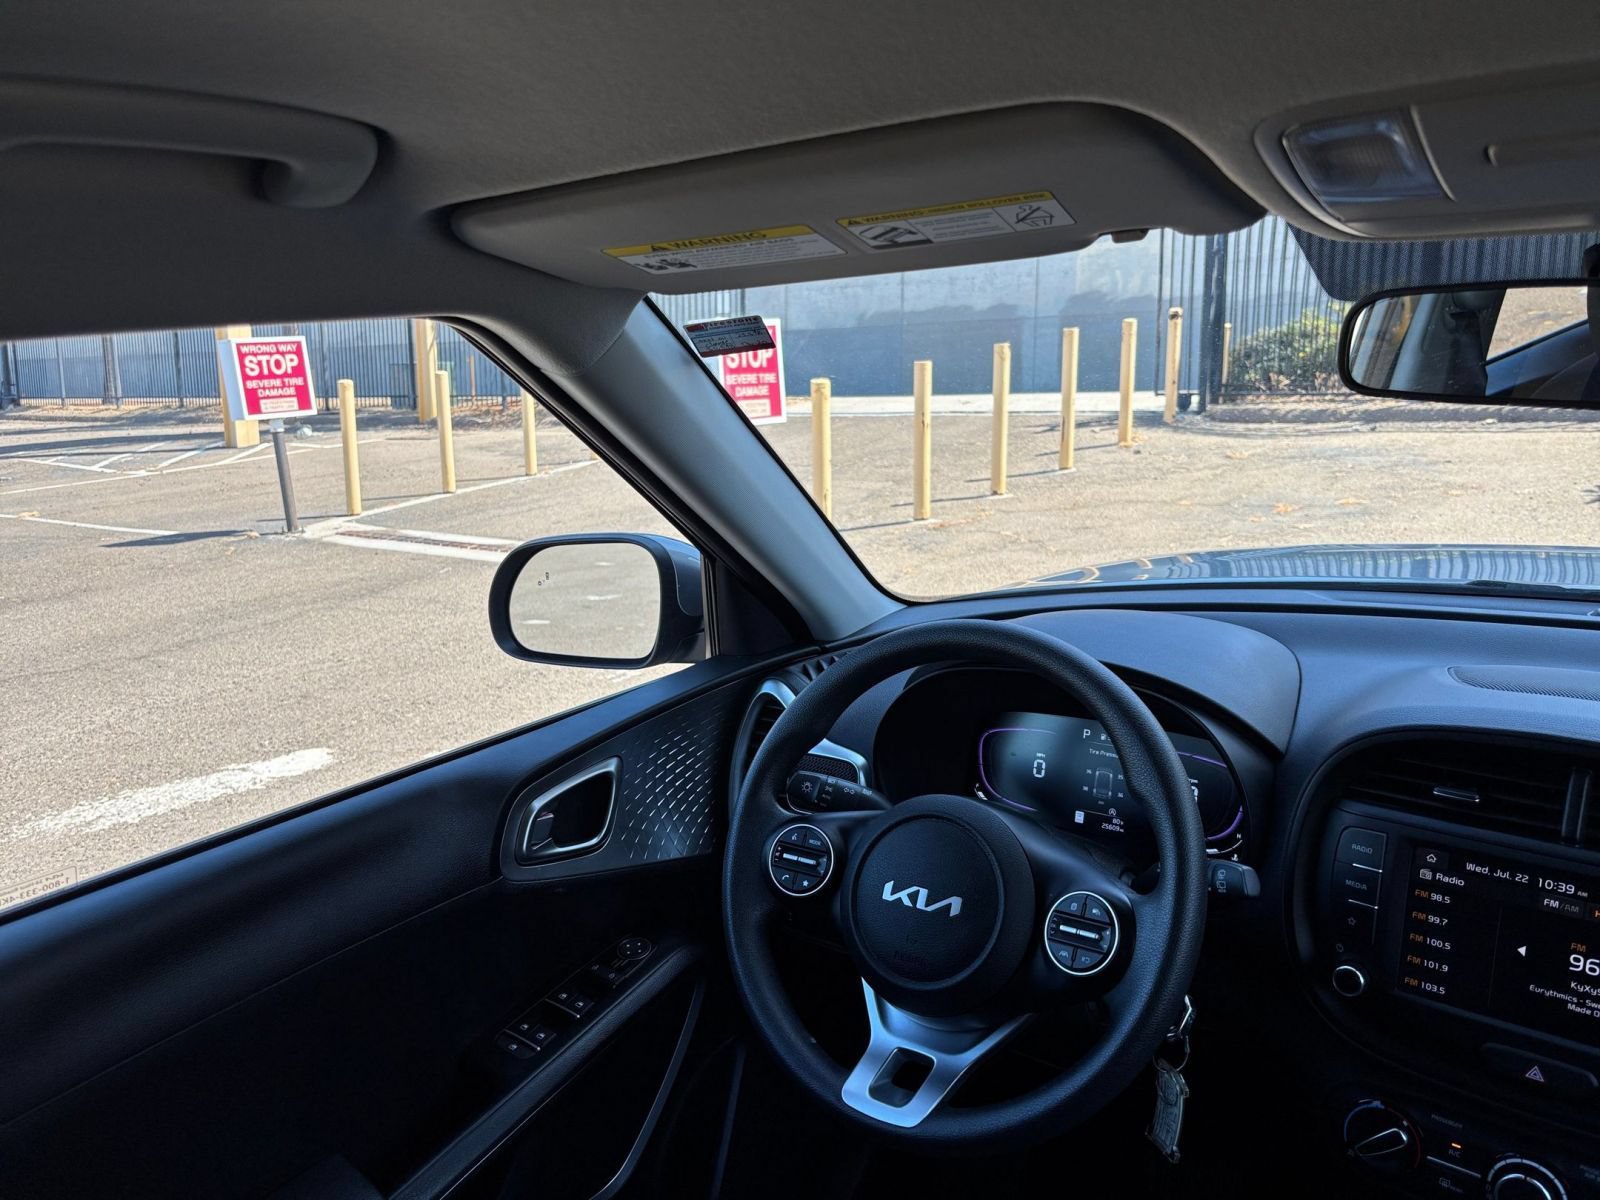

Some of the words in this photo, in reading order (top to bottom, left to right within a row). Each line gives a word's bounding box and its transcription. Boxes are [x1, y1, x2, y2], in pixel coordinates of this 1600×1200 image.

[670, 231, 767, 250] WARNING
[240, 344, 277, 354] WRONG
[278, 343, 297, 352] WAY
[244, 353, 299, 376] STOP
[725, 348, 774, 369] STOP
[246, 379, 282, 389] SEVERE
[284, 376, 304, 386] TIRE
[726, 373, 759, 385] SEVERE
[759, 372, 777, 384] TIRE
[257, 387, 296, 398] DAMAGE
[735, 385, 769, 398] DAMAGE
[1083, 728, 1091, 739] P
[1033, 759, 1046, 778] 0
[1351, 843, 1373, 855] RADIO
[1345, 879, 1368, 891] MEDIA
[1435, 873, 1465, 886] Radio
[1515, 873, 1529, 884] 22
[1538, 877, 1576, 895] 10:39
[1577, 890, 1589, 898] AM
[882, 880, 963, 917] KIA
[1415, 889, 1429, 899] FM
[1430, 892, 1451, 904] 98.5
[1412, 911, 1426, 921] FM
[1427, 915, 1448, 926] 99.7
[1409, 933, 1424, 943] FM
[1426, 937, 1451, 950] 100.5
[1570, 942, 1587, 953] FM
[1407, 955, 1421, 965] FM
[1424, 959, 1449, 972] 101.9
[1404, 976, 1418, 987] FM
[1421, 981, 1446, 995] 103.5
[1529, 984, 1578, 1003] Eurythmics
[1567, 1003, 1592, 1016] Made
